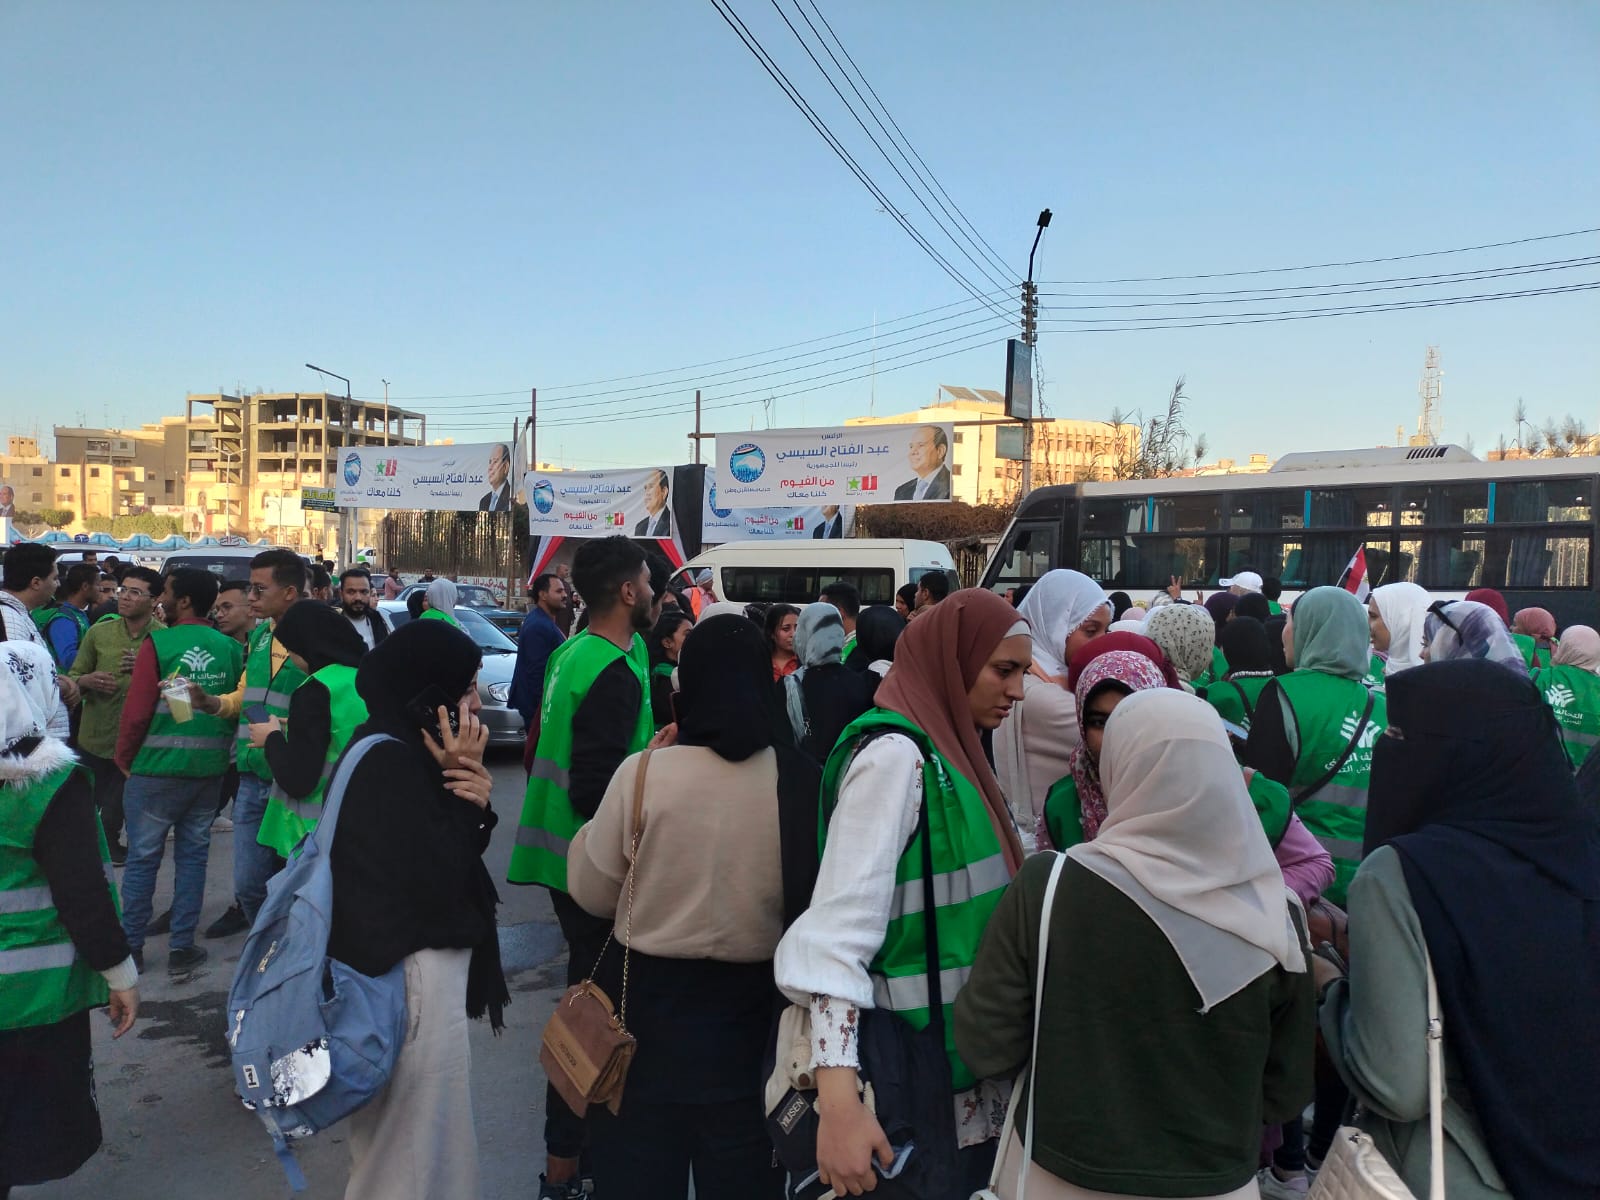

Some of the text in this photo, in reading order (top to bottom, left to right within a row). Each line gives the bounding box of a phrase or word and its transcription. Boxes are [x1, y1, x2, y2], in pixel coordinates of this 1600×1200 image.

[776, 443, 889, 463] عبد الفتاح السيسي
[412, 472, 483, 488] عبد الفتاح السيسي
[780, 475, 835, 488] من الفيوم
[366, 487, 386, 498] معاك
[387, 487, 401, 497] كلنا
[560, 484, 632, 498] عبد الفتاح السيسي
[787, 491, 809, 499] معاك
[563, 510, 587, 521] الفيوم
[587, 512, 598, 521] من
[744, 513, 779, 526] من الفيوم
